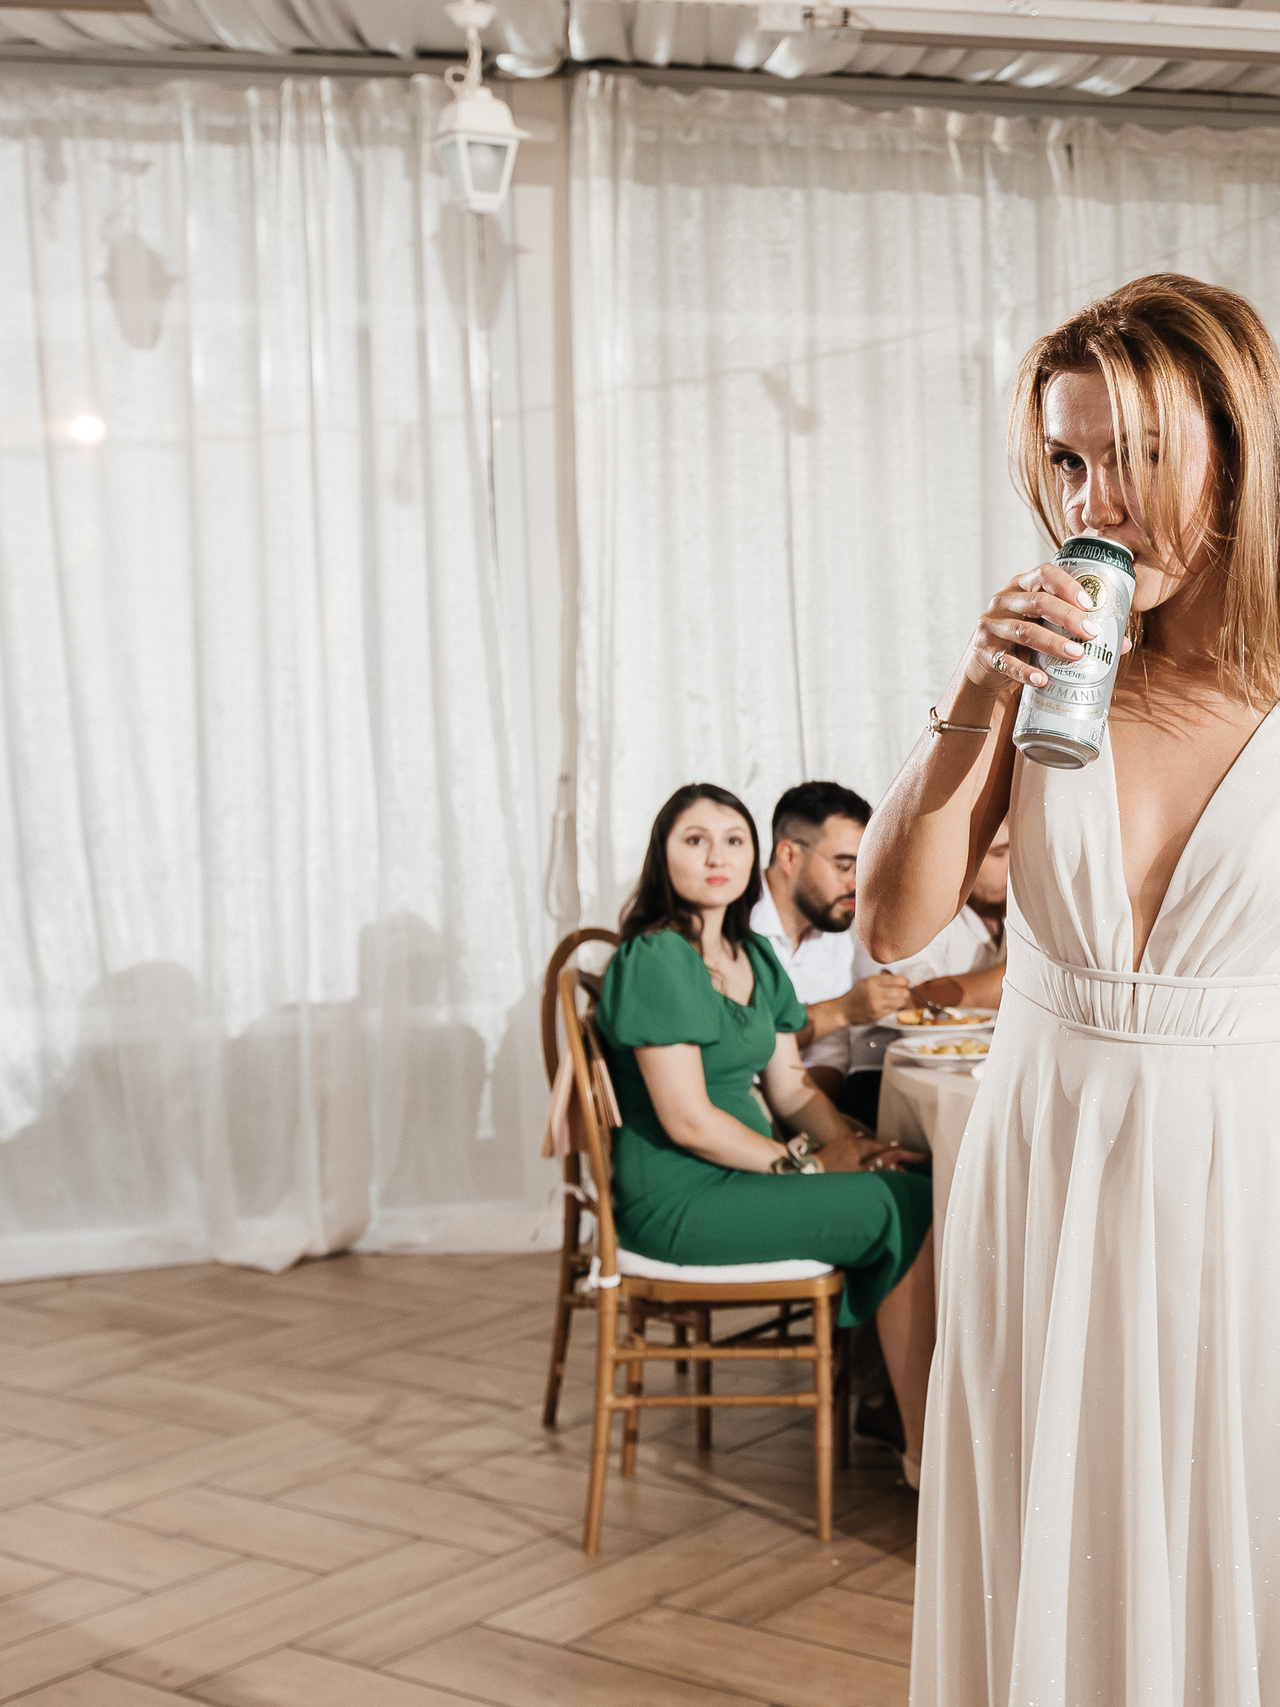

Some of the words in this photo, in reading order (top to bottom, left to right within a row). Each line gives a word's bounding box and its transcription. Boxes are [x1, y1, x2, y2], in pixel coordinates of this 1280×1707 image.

[1073, 544, 1112, 562] BEBIDAS
[1053, 667, 1087, 680] PILSENER
[1047, 683, 1103, 702] RMANIA
